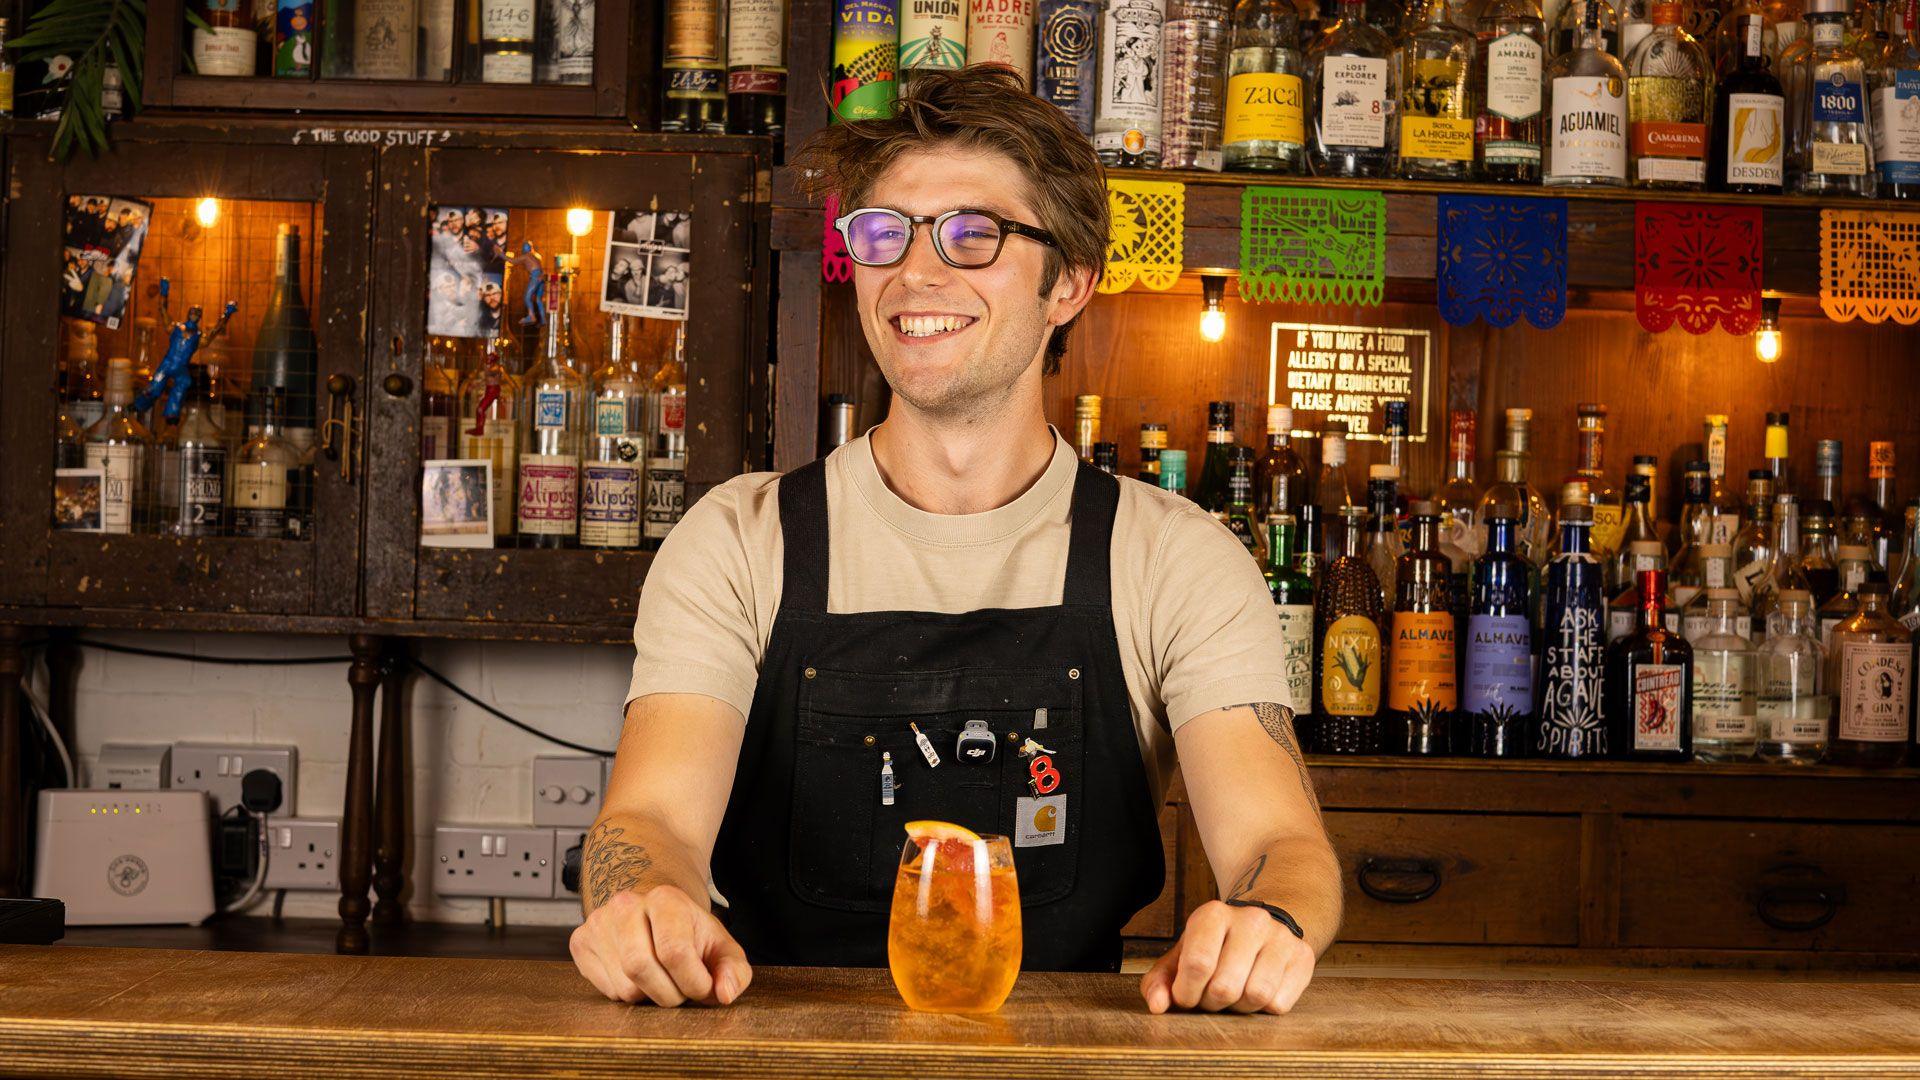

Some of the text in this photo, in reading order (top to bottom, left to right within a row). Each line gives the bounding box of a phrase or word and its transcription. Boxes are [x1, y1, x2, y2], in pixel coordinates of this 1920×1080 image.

[972, 0, 1030, 16] MADRE
[841, 11, 895, 26] VIDA
[976, 15, 1025, 26] MEZCAL
[1334, 71, 1377, 80] EXPLORER
[1372, 100, 1380, 114] 8
[1820, 94, 1856, 110] 1800
[1560, 111, 1621, 137] AGUAMIEL
[311, 128, 438, 146] THE GOOD STUFF
[1412, 130, 1472, 142] LA HIGUERA
[1648, 131, 1701, 145] CAMARENA
[1297, 330, 1309, 348] IF
[1312, 332, 1333, 350] YOU
[1336, 333, 1364, 351] HAVE
[1367, 334, 1374, 351] A
[1288, 351, 1412, 374] ALLERGY OR A SPECIAL
[1287, 371, 1334, 390] DIETARY
[1292, 392, 1334, 410] PLEASE
[1335, 395, 1374, 412] ADVISE
[523, 478, 575, 511] Alipús
[585, 480, 637, 513] Alipús
[650, 482, 684, 513] Alip
[194, 504, 204, 524] 2
[1560, 606, 1600, 628] ASK
[1328, 635, 1378, 650] NIXTA
[1400, 630, 1454, 642] ALMAVE
[1474, 632, 1529, 646] ALMAVE
[1559, 628, 1598, 648] THE
[1546, 646, 1604, 664] STAFF
[1548, 664, 1604, 680] ABOUT
[1542, 678, 1606, 720] AGAVE
[1872, 702, 1892, 713] GIN
[1537, 721, 1608, 757] SPIRITS
